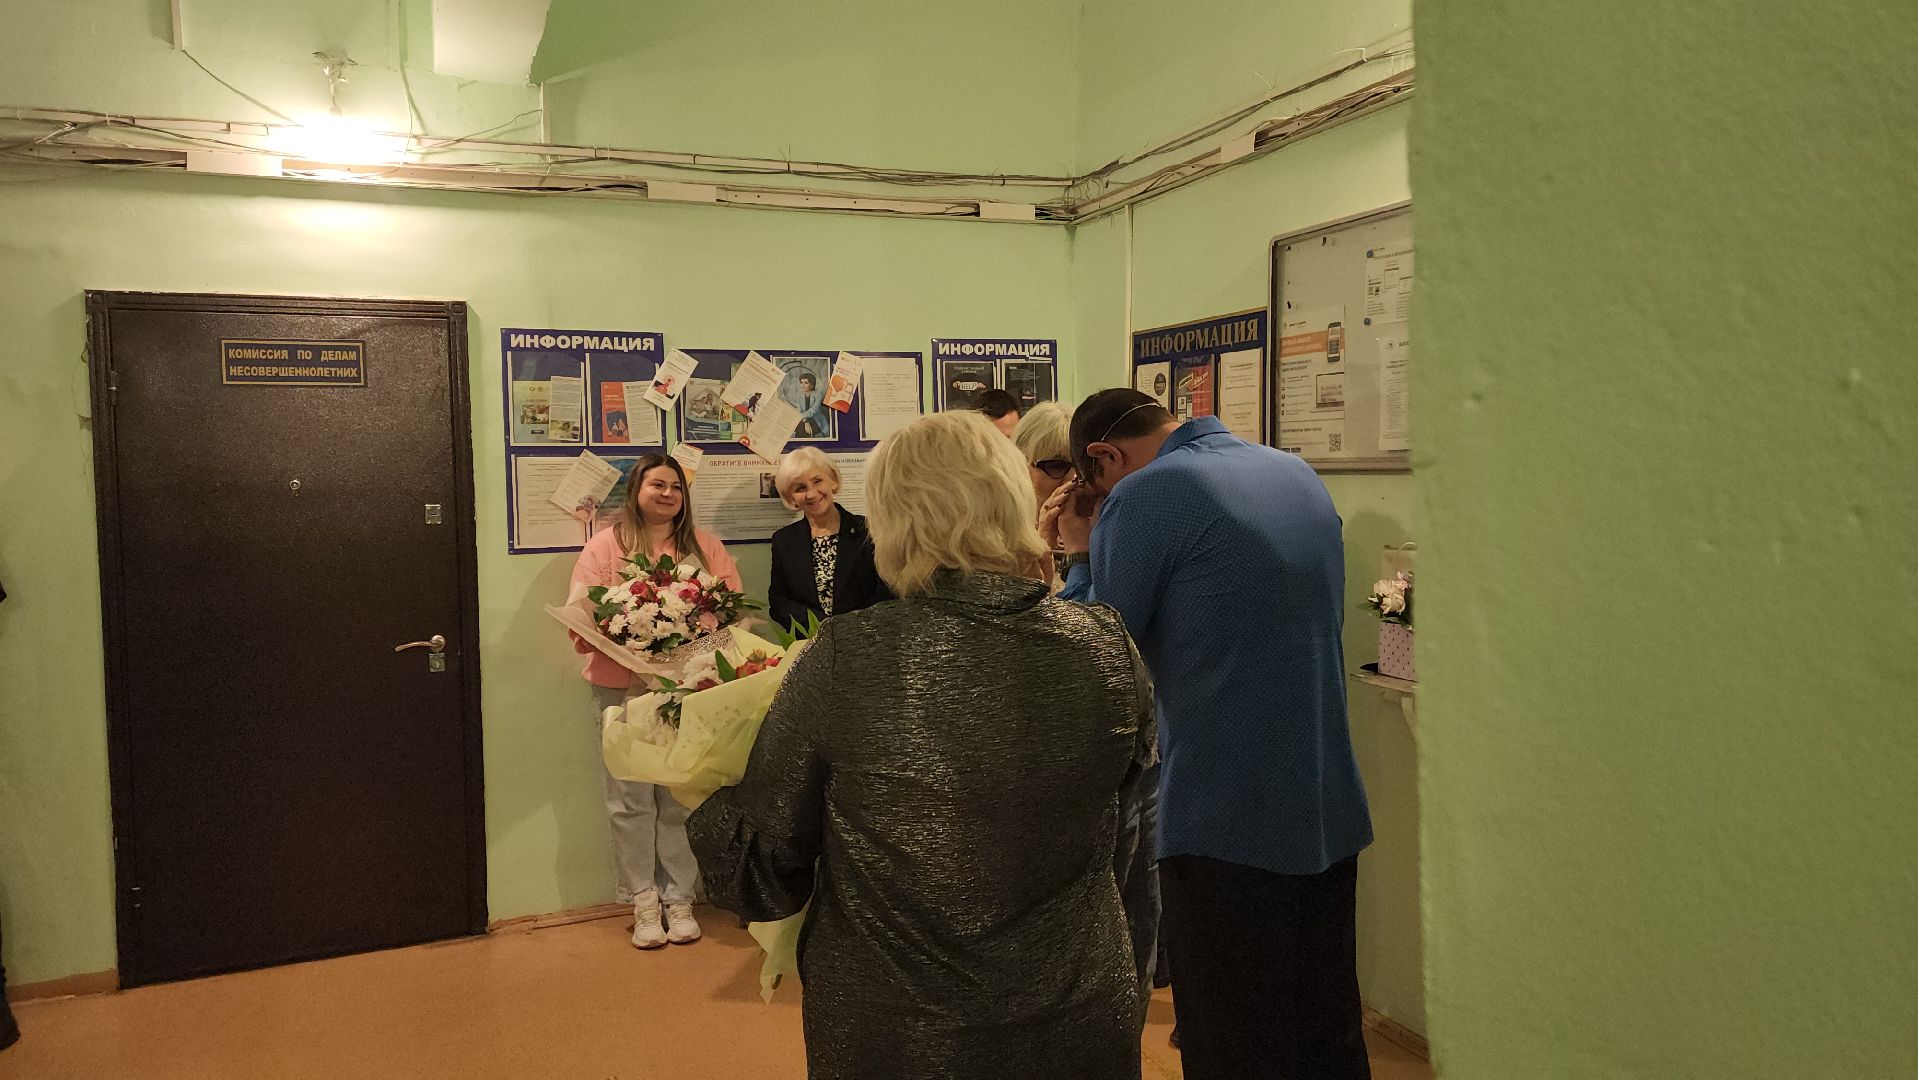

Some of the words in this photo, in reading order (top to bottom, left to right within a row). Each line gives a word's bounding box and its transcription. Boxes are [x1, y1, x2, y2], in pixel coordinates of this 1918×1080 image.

[510, 333, 655, 353] ИНФОРМАЦИЯ
[1140, 318, 1259, 358] ИНФОРМАЦИЯ
[228, 348, 288, 360] КОМИССИЯ
[297, 349, 313, 360] ПО
[320, 350, 357, 362] ДЕЛАМ
[938, 342, 1050, 358] ИНФОРМАЦИЯ
[229, 365, 358, 378] НЕСОВЕРШЕННОЛЕТНИХ
